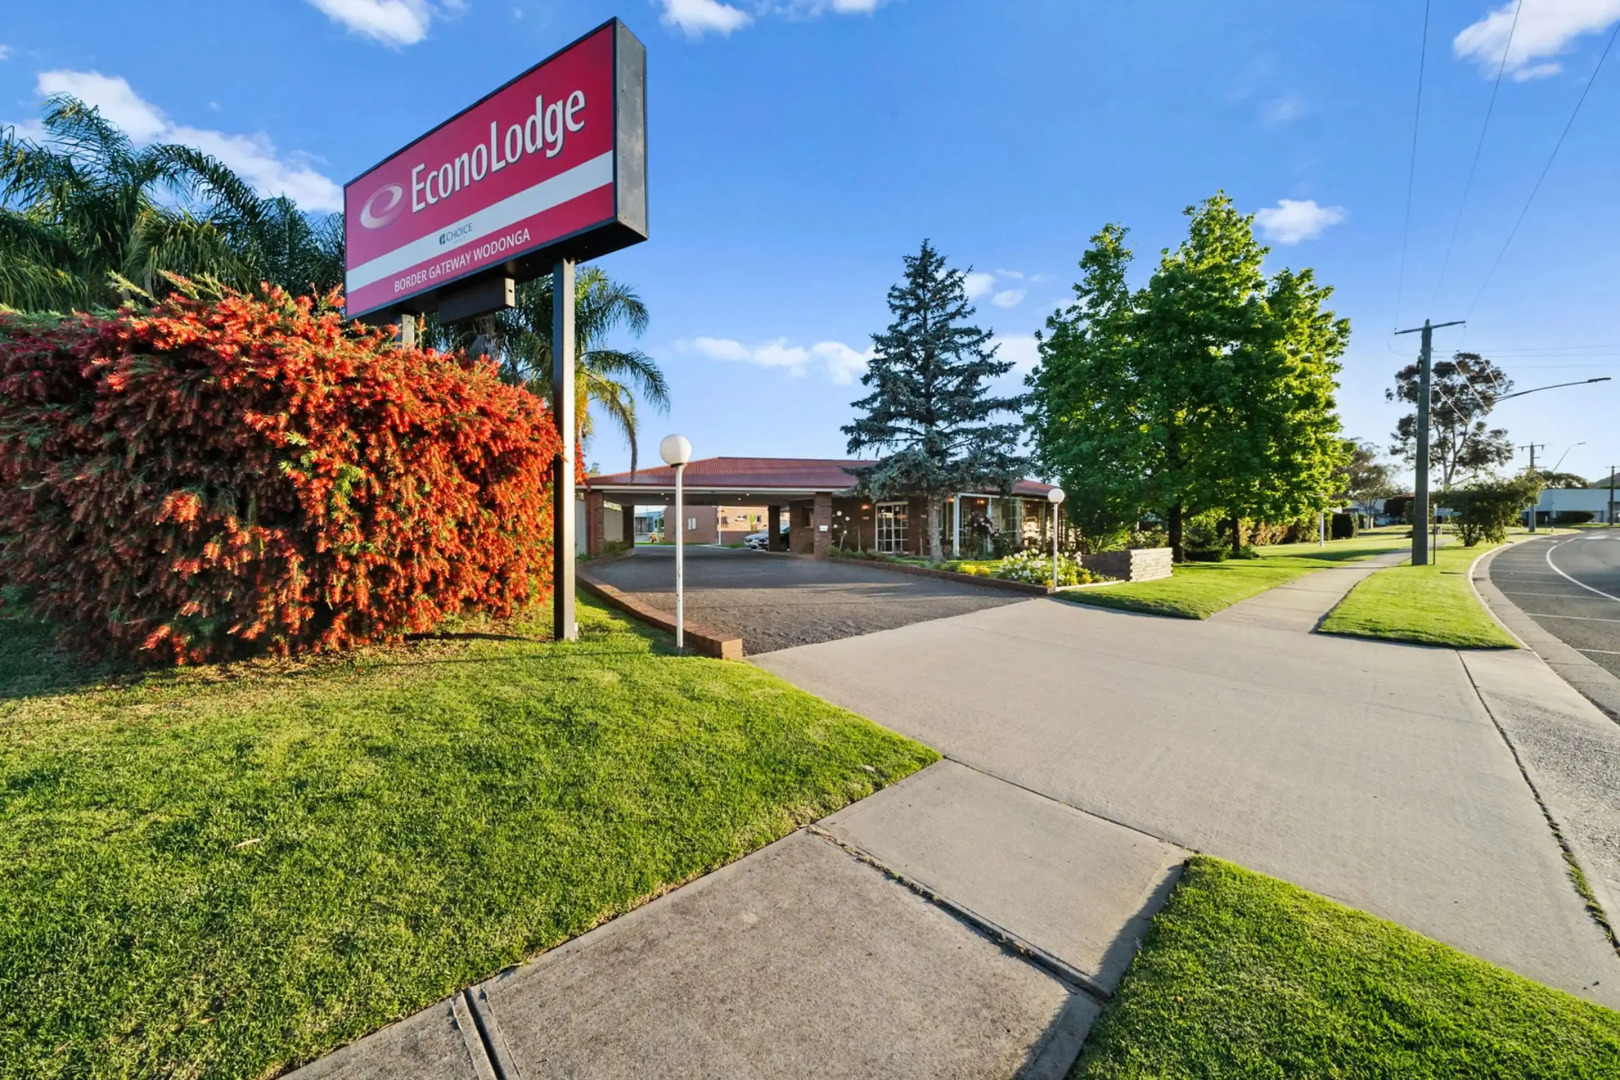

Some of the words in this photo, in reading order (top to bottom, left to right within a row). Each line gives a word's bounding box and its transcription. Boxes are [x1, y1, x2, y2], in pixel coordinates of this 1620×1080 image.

[411, 90, 586, 213] EconoLodge
[394, 270, 428, 293] BORDER
[428, 251, 472, 279] GATEWAY
[473, 228, 531, 262] WODONGA
[446, 222, 473, 242] CHOICE
